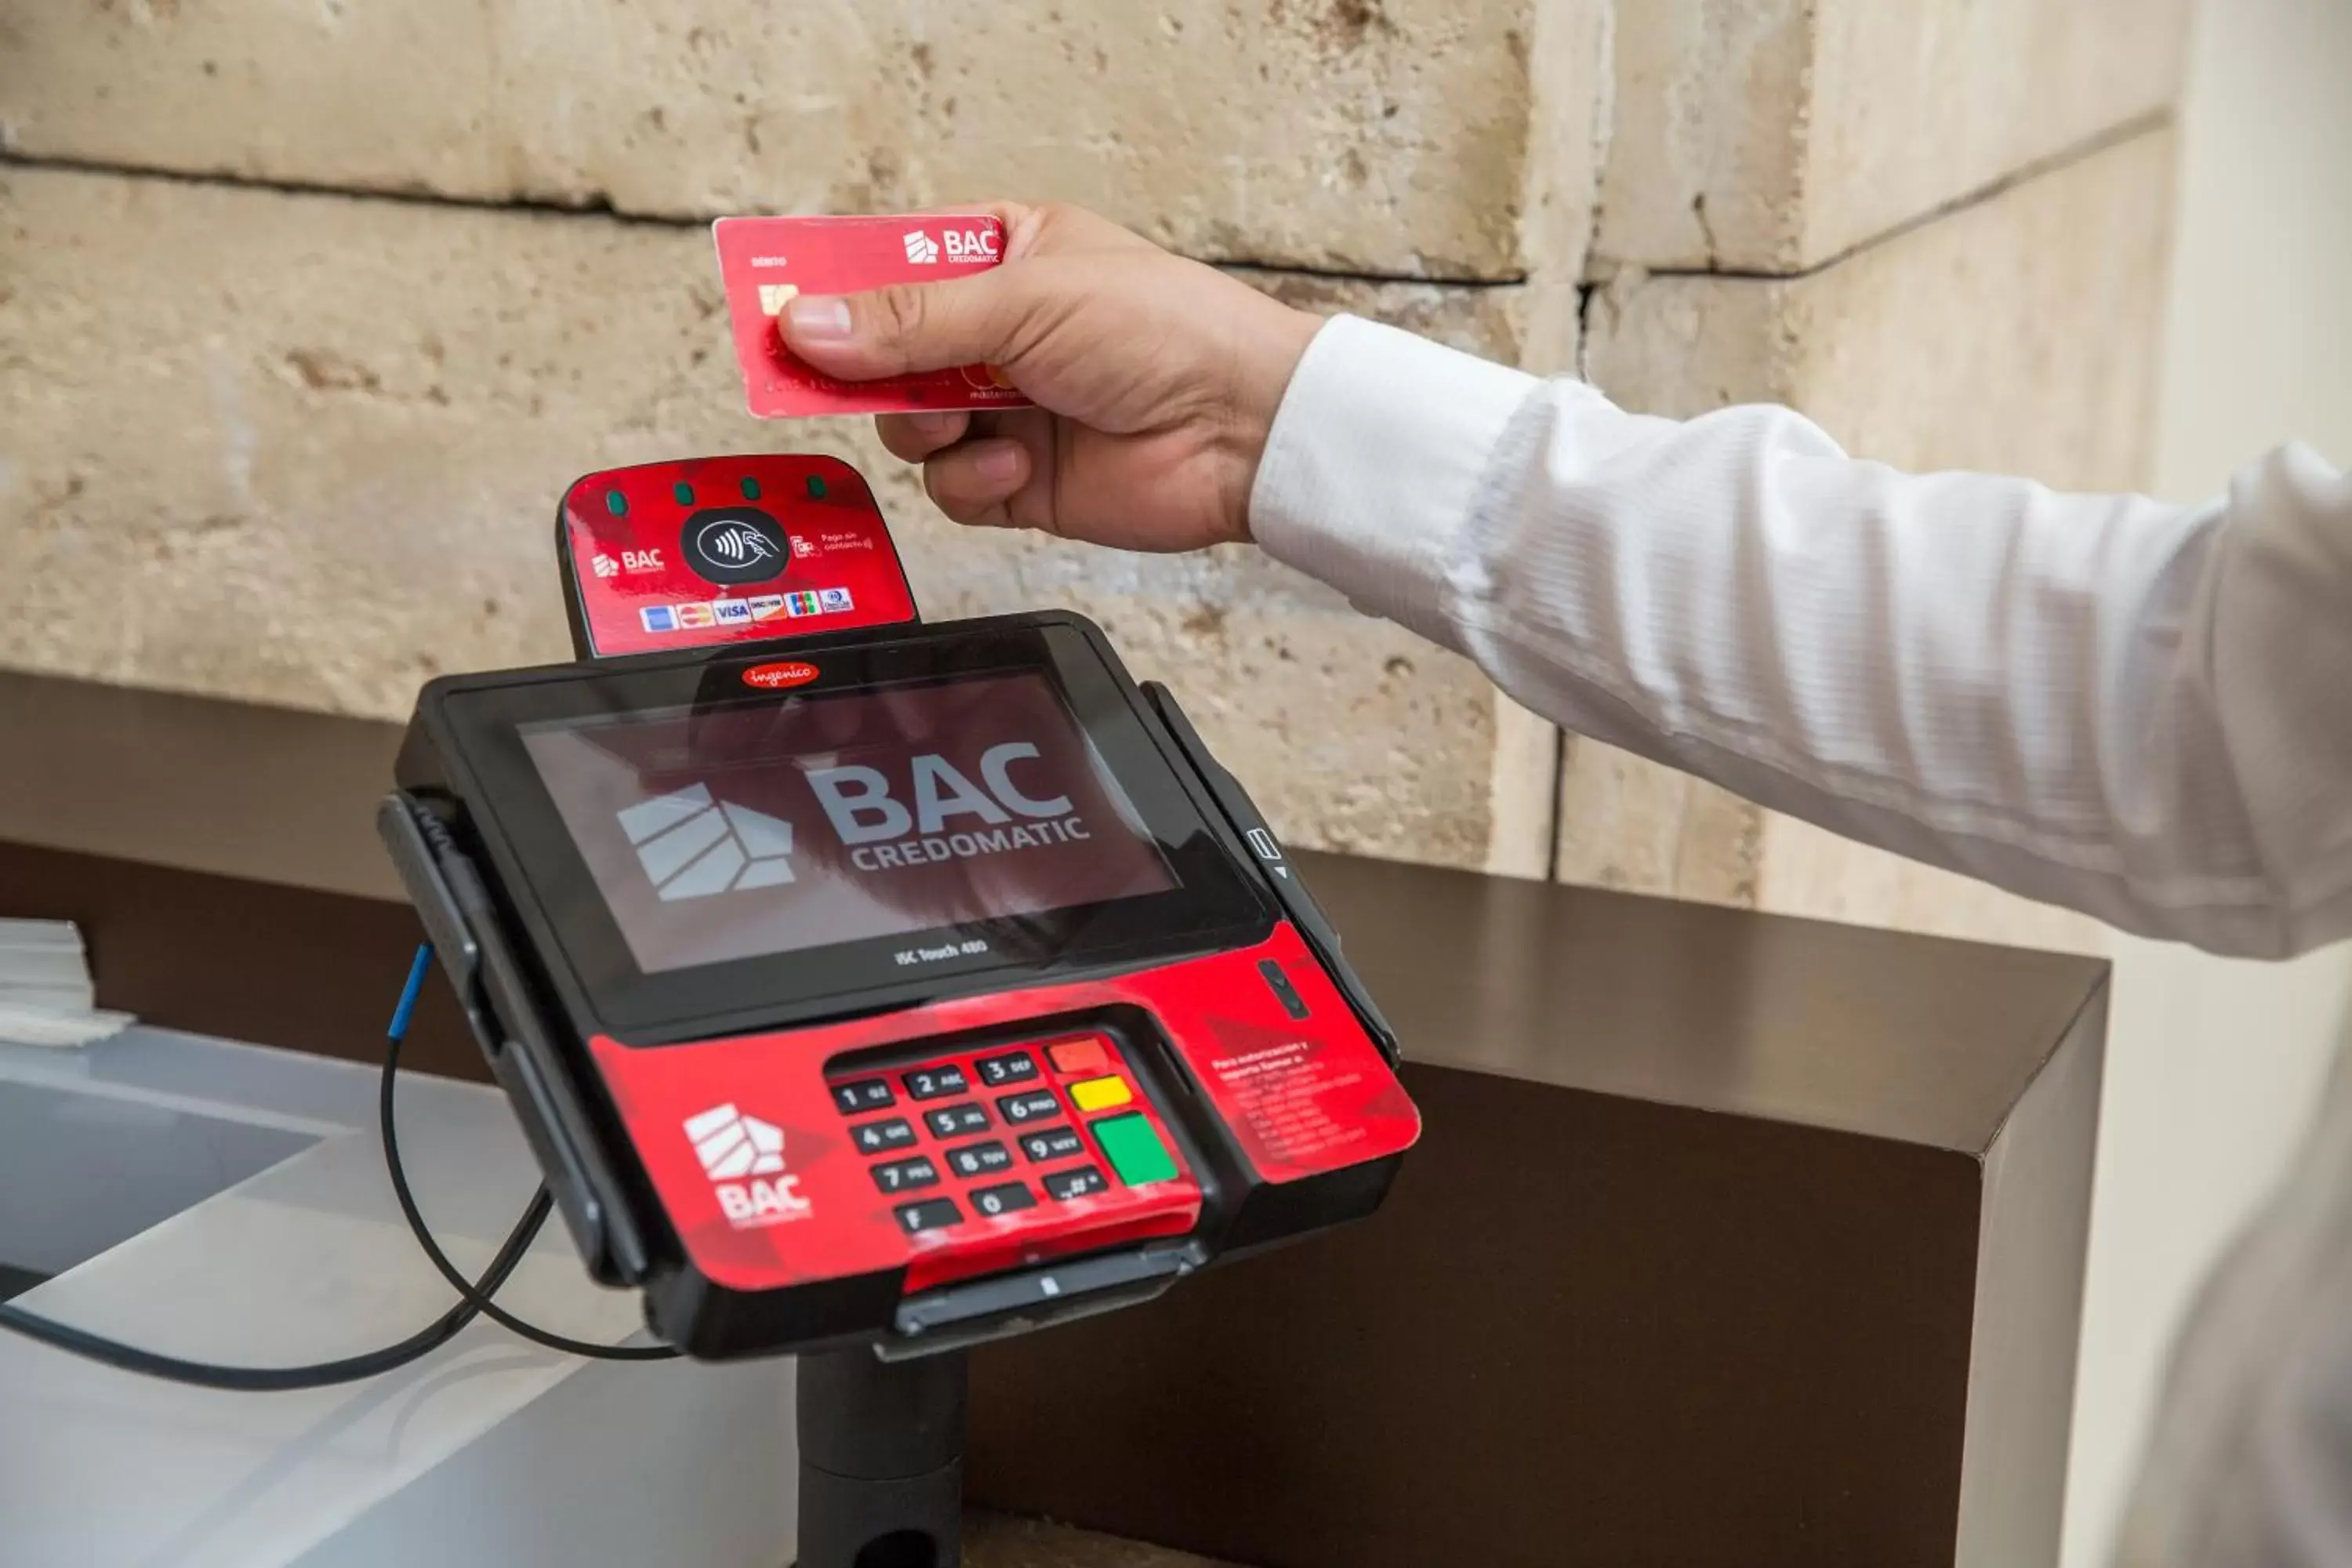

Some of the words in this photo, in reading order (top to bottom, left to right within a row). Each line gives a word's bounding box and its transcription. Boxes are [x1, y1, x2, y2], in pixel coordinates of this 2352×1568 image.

[943, 230, 997, 255] BAC
[621, 548, 665, 568] BAC
[717, 604, 748, 618] VISA
[805, 741, 1075, 845] BAC
[851, 817, 1090, 872] CREDOMATIC
[988, 1062, 1006, 1080] 3
[916, 1075, 935, 1093] 2
[842, 1088, 858, 1107] 1
[1011, 1100, 1028, 1119] 6
[937, 1114, 956, 1132] 5
[862, 1127, 881, 1147] 4
[1030, 1138, 1048, 1159] 9
[959, 1152, 980, 1173] 8
[883, 1167, 900, 1189] 7
[714, 1174, 811, 1221] BAC
[982, 1193, 1003, 1214] 0
